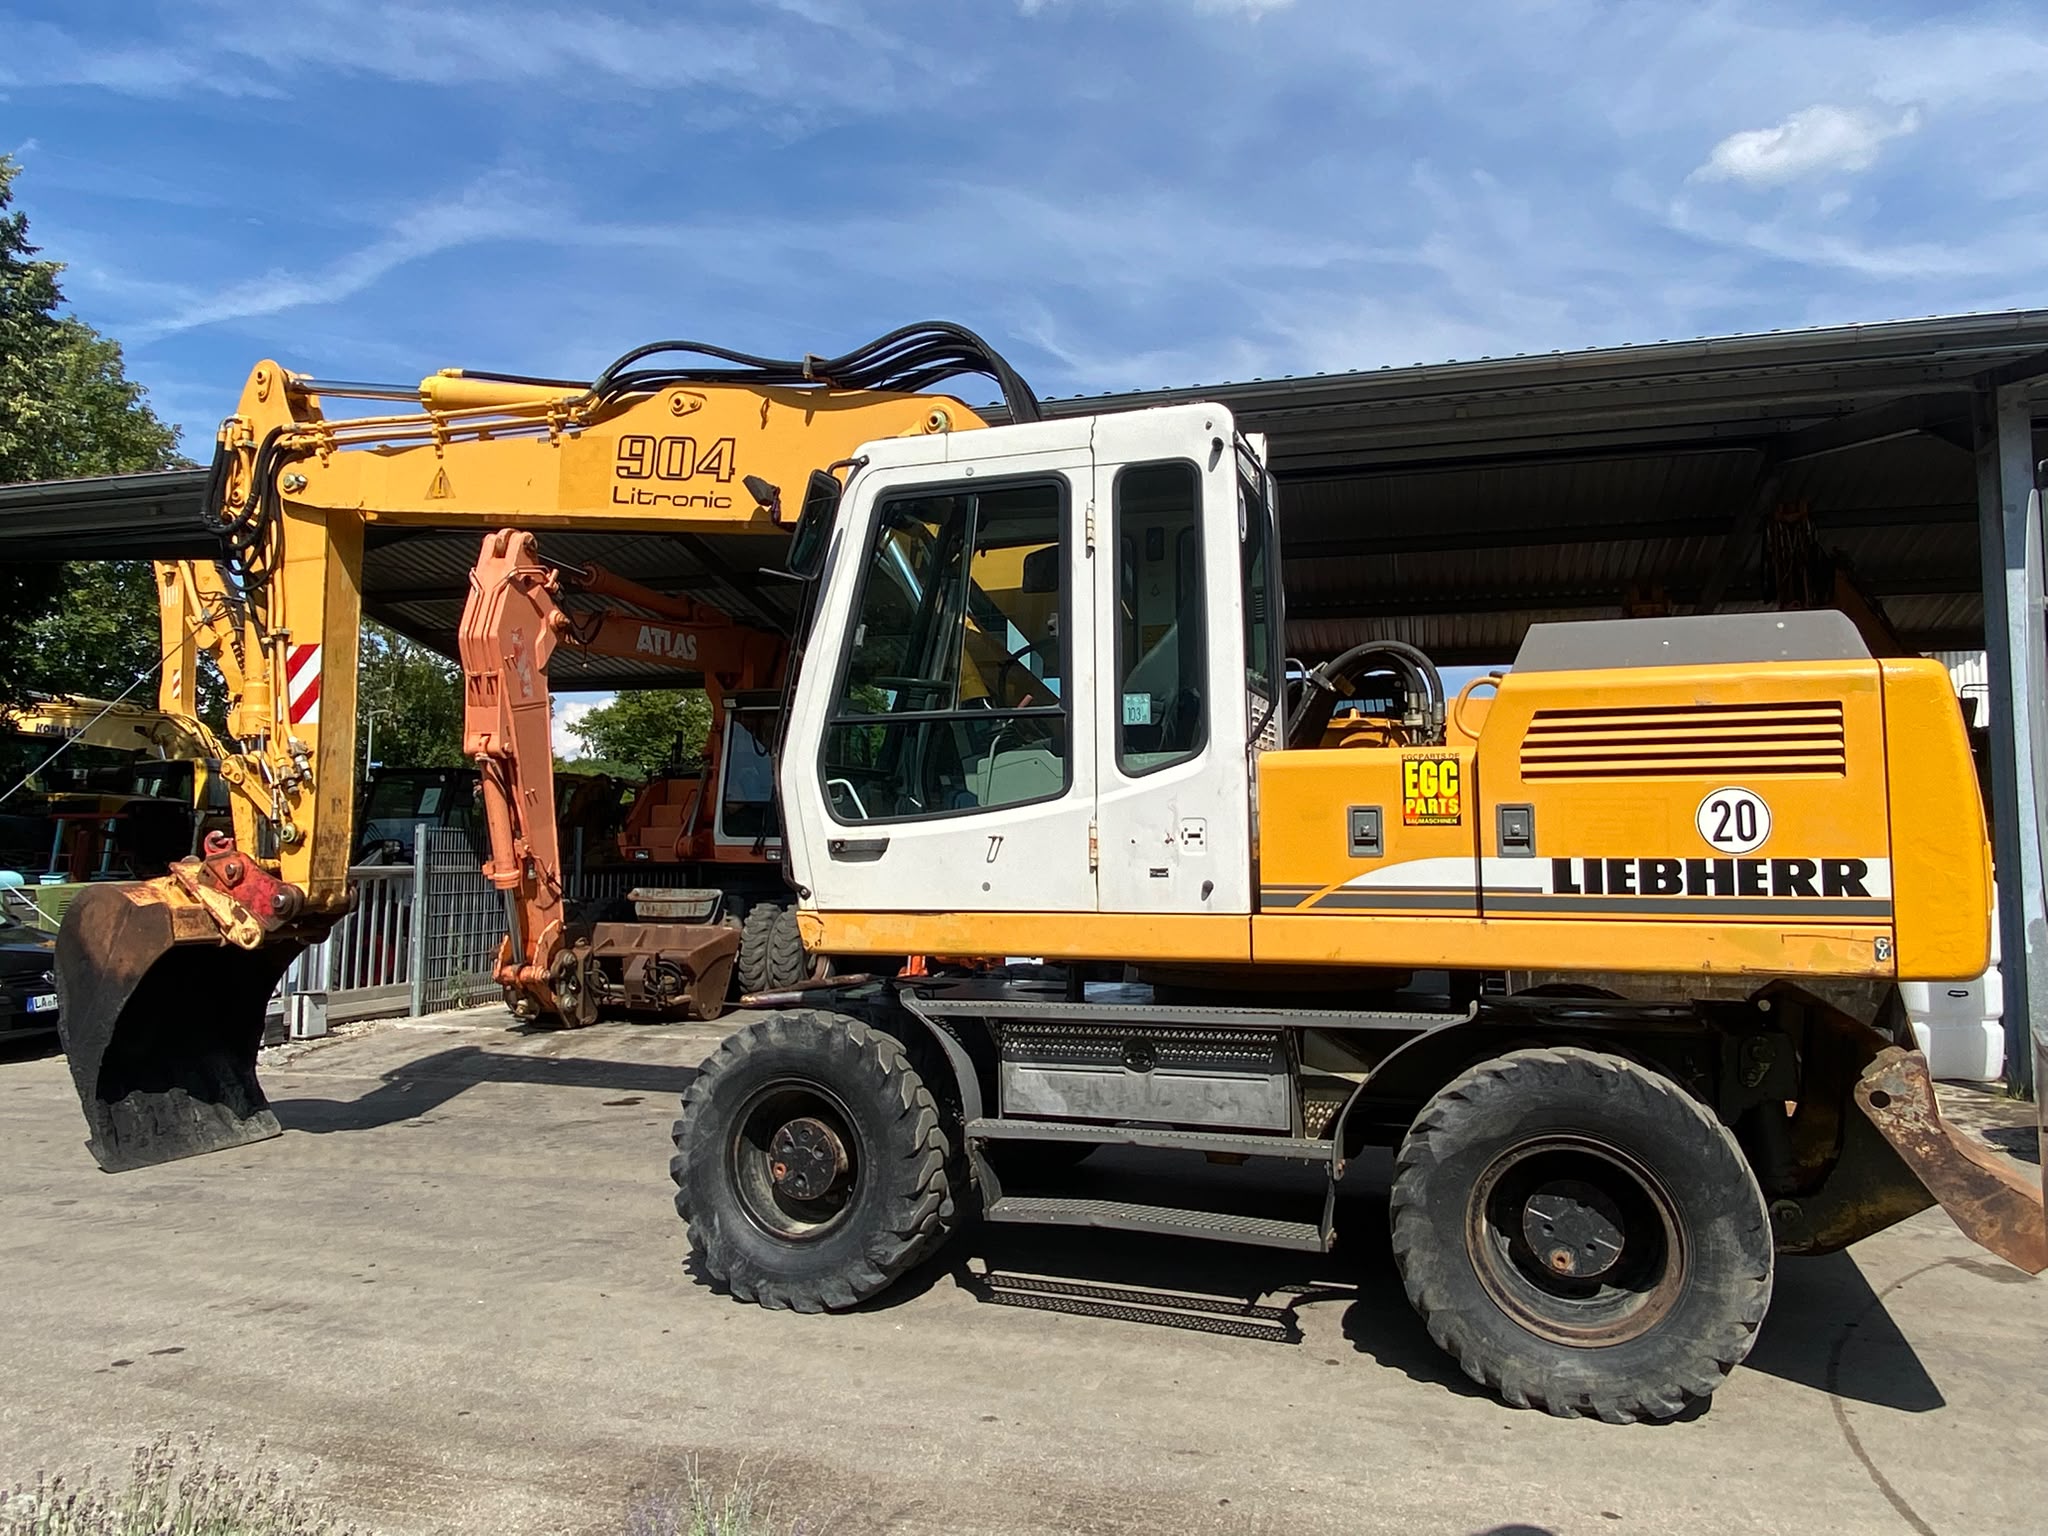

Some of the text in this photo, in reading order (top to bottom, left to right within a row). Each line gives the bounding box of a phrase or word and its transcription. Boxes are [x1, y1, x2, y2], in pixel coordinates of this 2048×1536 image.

[616, 435, 735, 483] 904
[613, 486, 732, 508] Litronic
[636, 626, 697, 660] ATLAS
[1405, 760, 1458, 797] EGC
[1406, 798, 1459, 814] PARTS
[1711, 800, 1757, 842] 20
[1552, 858, 1872, 897] LIEBHERR
